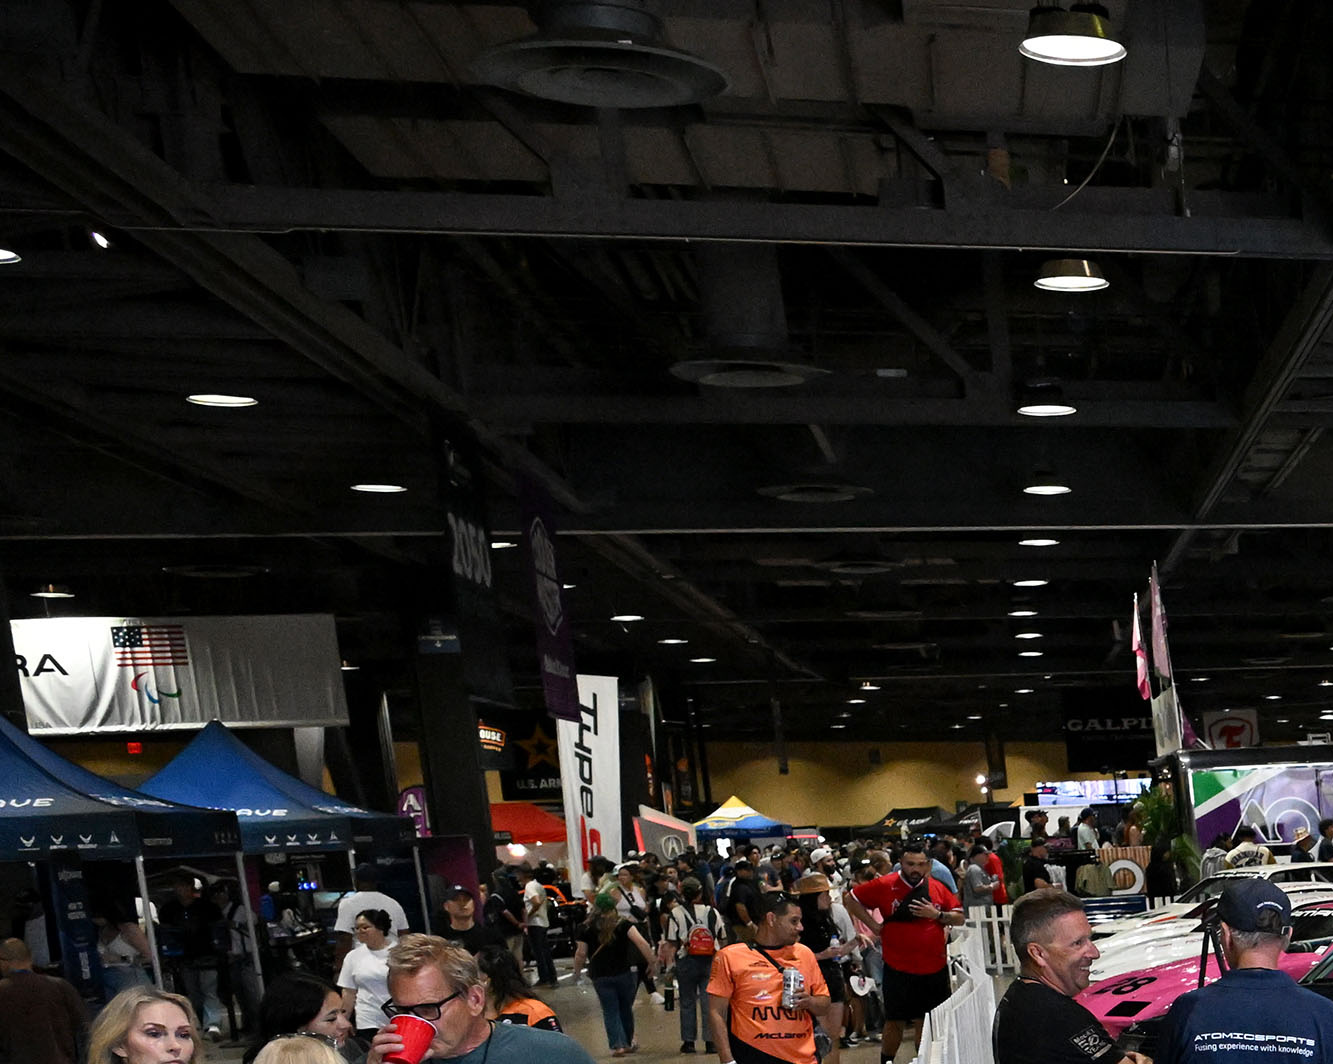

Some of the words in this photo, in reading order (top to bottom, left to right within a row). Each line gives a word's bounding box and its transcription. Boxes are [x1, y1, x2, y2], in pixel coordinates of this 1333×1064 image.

[1067, 716, 1153, 731] GALPI
[575, 693, 598, 818] Type
[753, 1032, 808, 1040] McLaren
[1194, 1032, 1316, 1047] ATOMICSPORTS
[1195, 1044, 1218, 1053] Fusing
[1219, 1043, 1259, 1054] experience
[1261, 1045, 1277, 1053] with
[1278, 1046, 1314, 1058] knowledge
